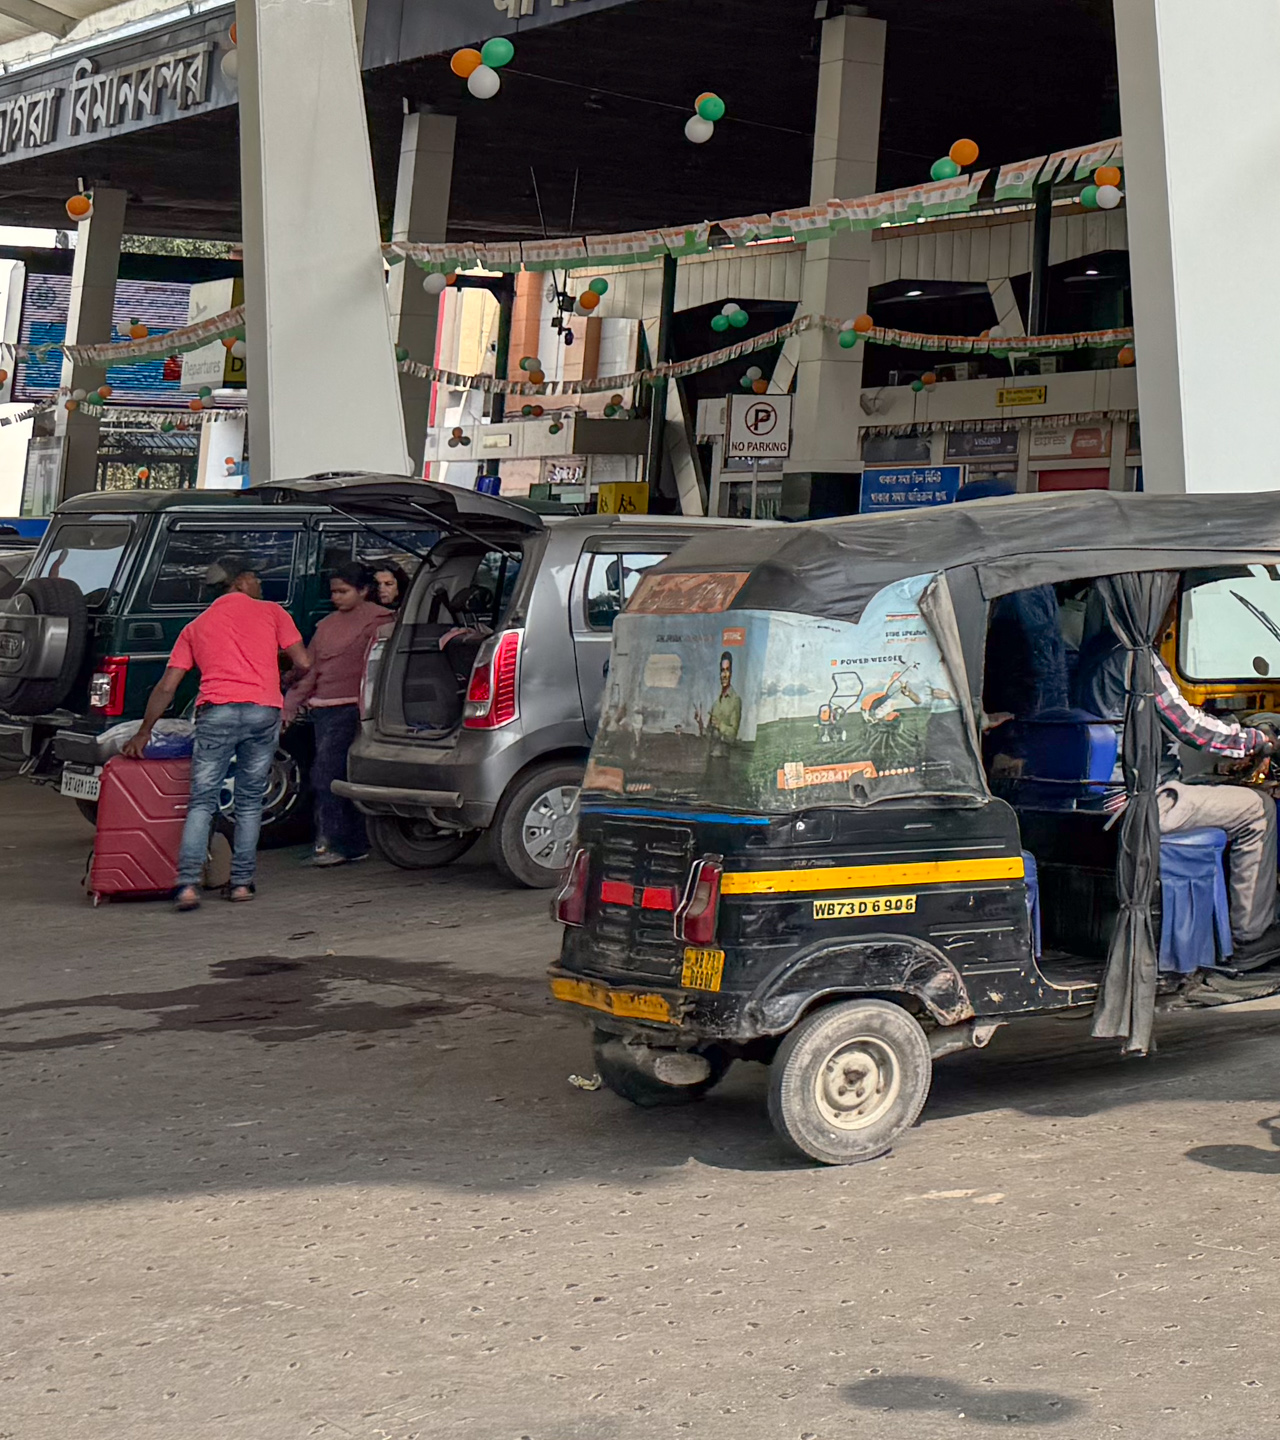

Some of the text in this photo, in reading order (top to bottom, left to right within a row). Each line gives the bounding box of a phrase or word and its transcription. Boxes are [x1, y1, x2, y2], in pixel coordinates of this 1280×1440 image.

[67, 41, 215, 137] বিমানবন্দর
[184, 358, 222, 380] Departures
[731, 441, 788, 452] NO PARKING
